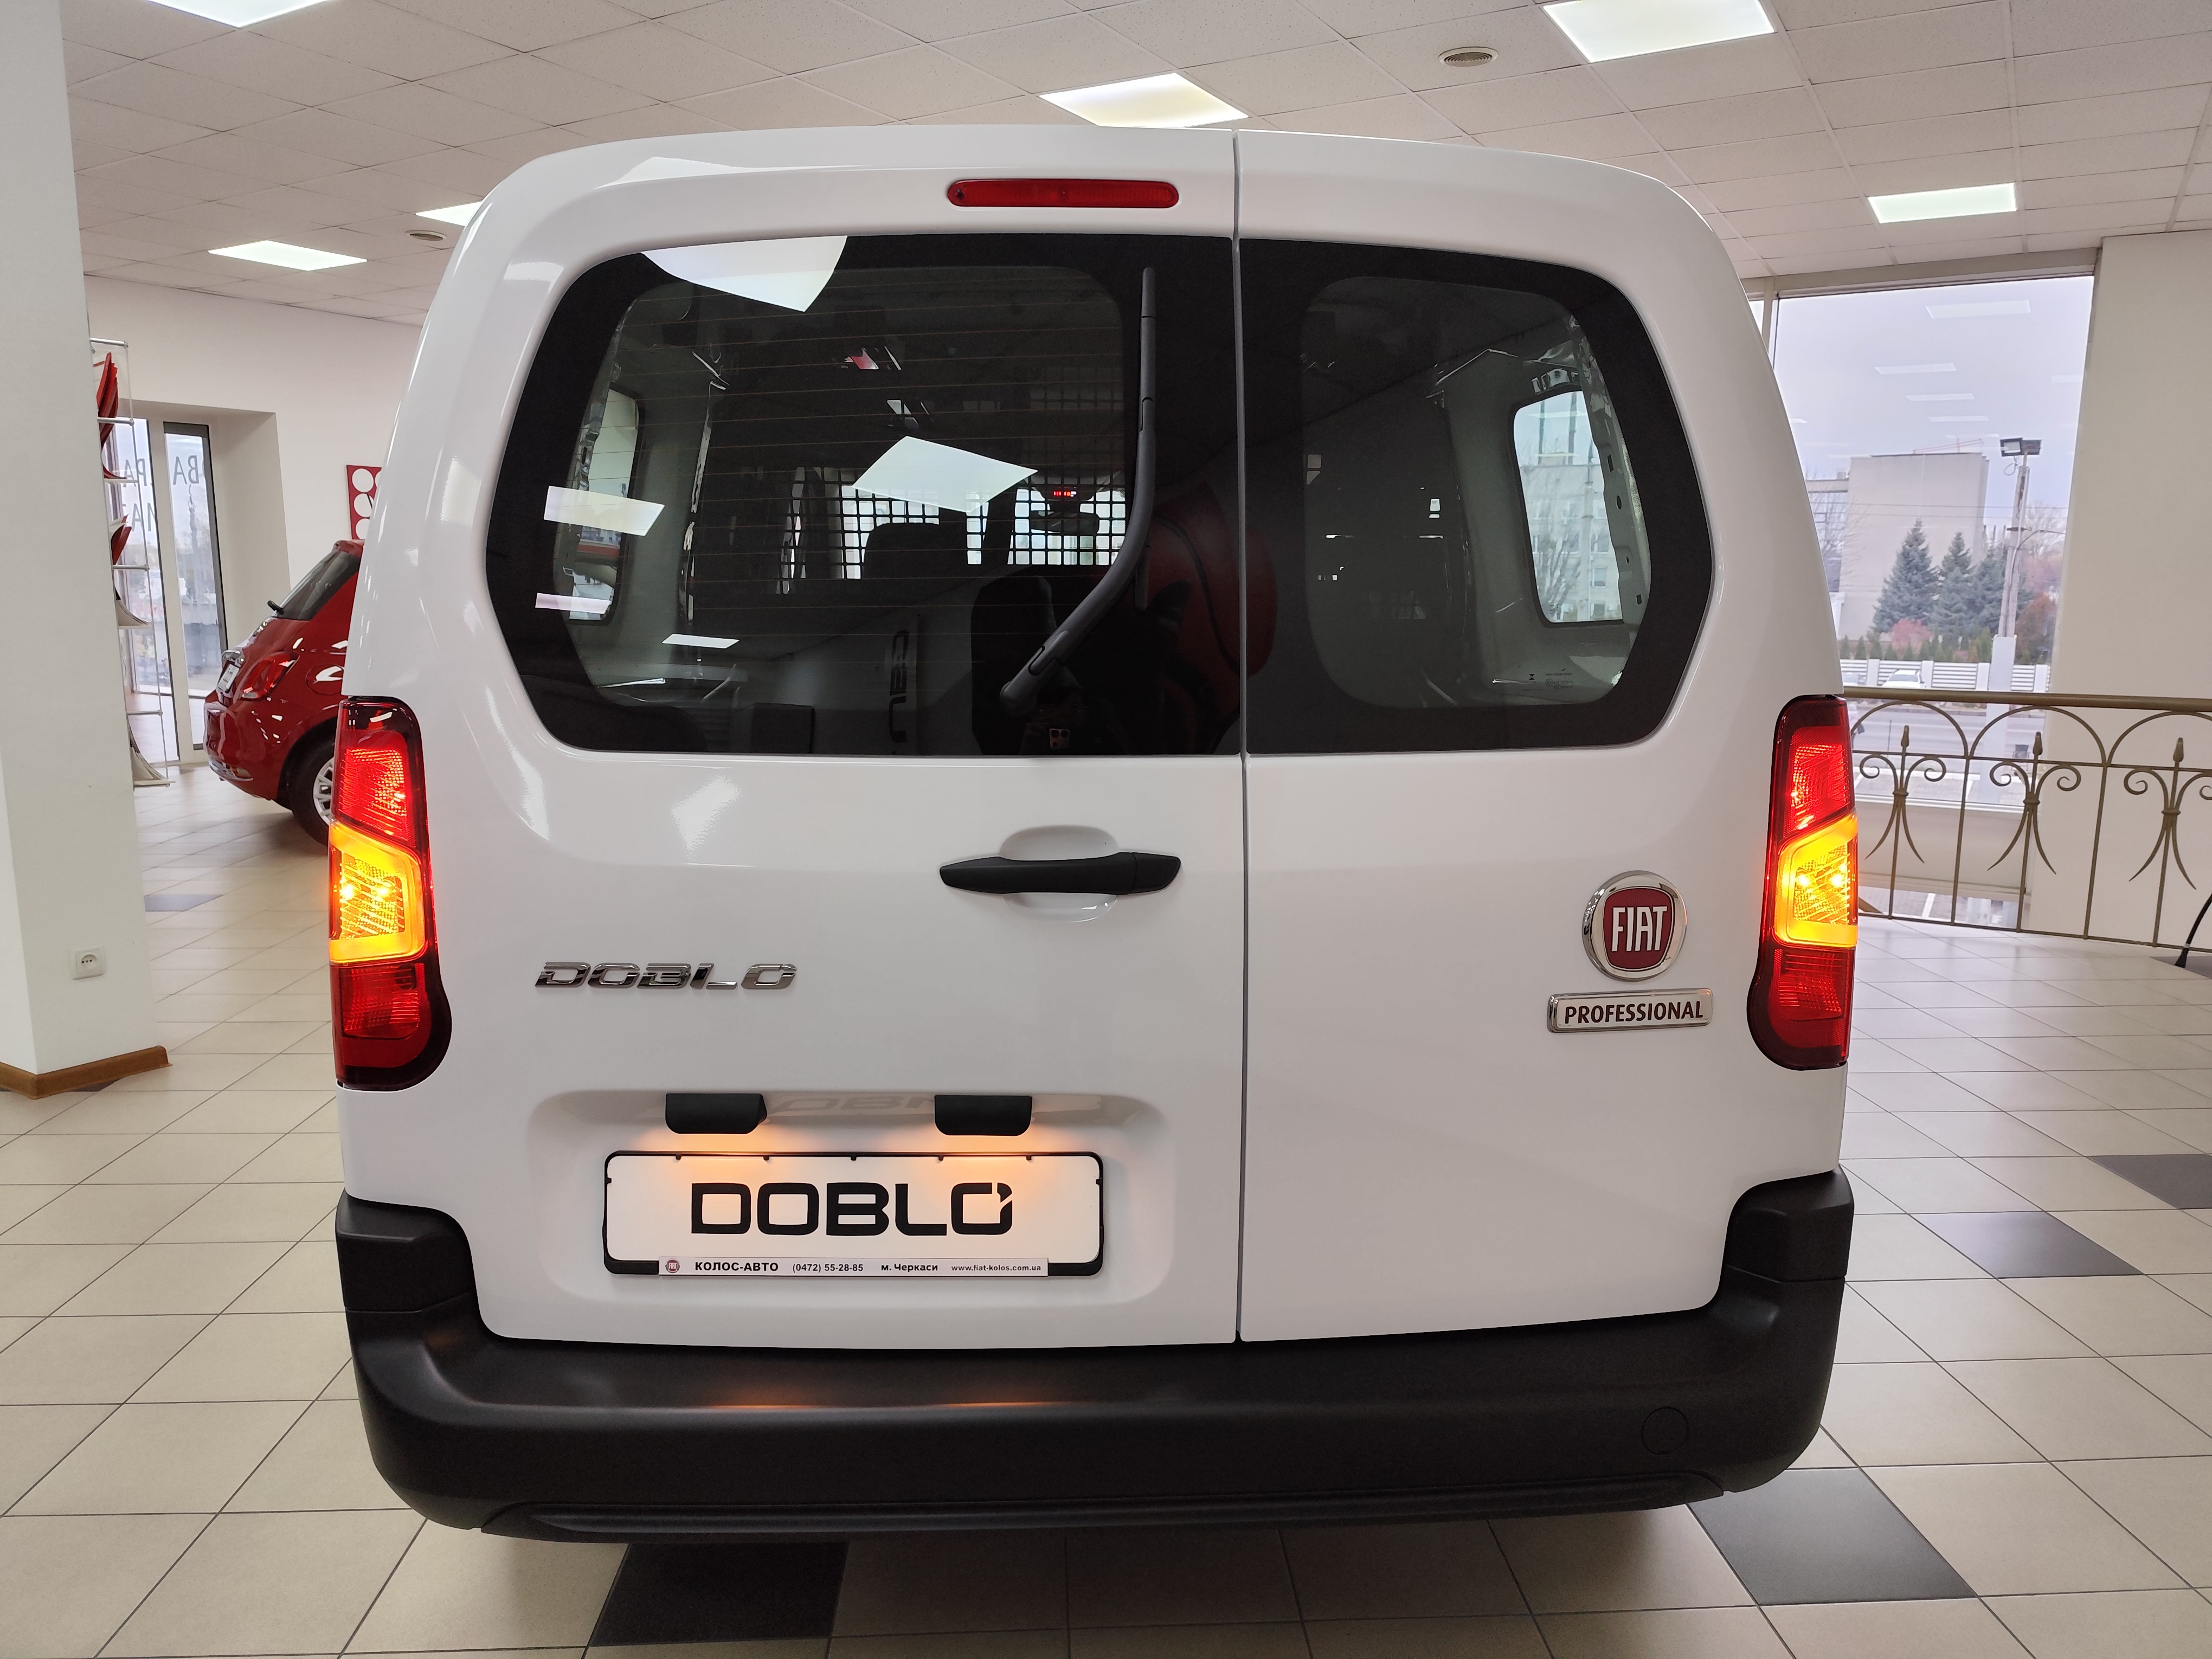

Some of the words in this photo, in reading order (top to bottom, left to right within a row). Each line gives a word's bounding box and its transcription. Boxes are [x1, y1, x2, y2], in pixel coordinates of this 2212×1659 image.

[1611, 906, 1668, 952] FIAT
[536, 962, 798, 989] DOBLO
[1564, 1001, 1703, 1024] PROFESSIONAL
[691, 1182, 1013, 1236] DOBLO
[695, 1262, 779, 1271] КОЛОС-АВТО
[793, 1264, 821, 1274] (0472)
[824, 1264, 864, 1272] 55-28-85
[894, 1263, 938, 1272] Черкаси
